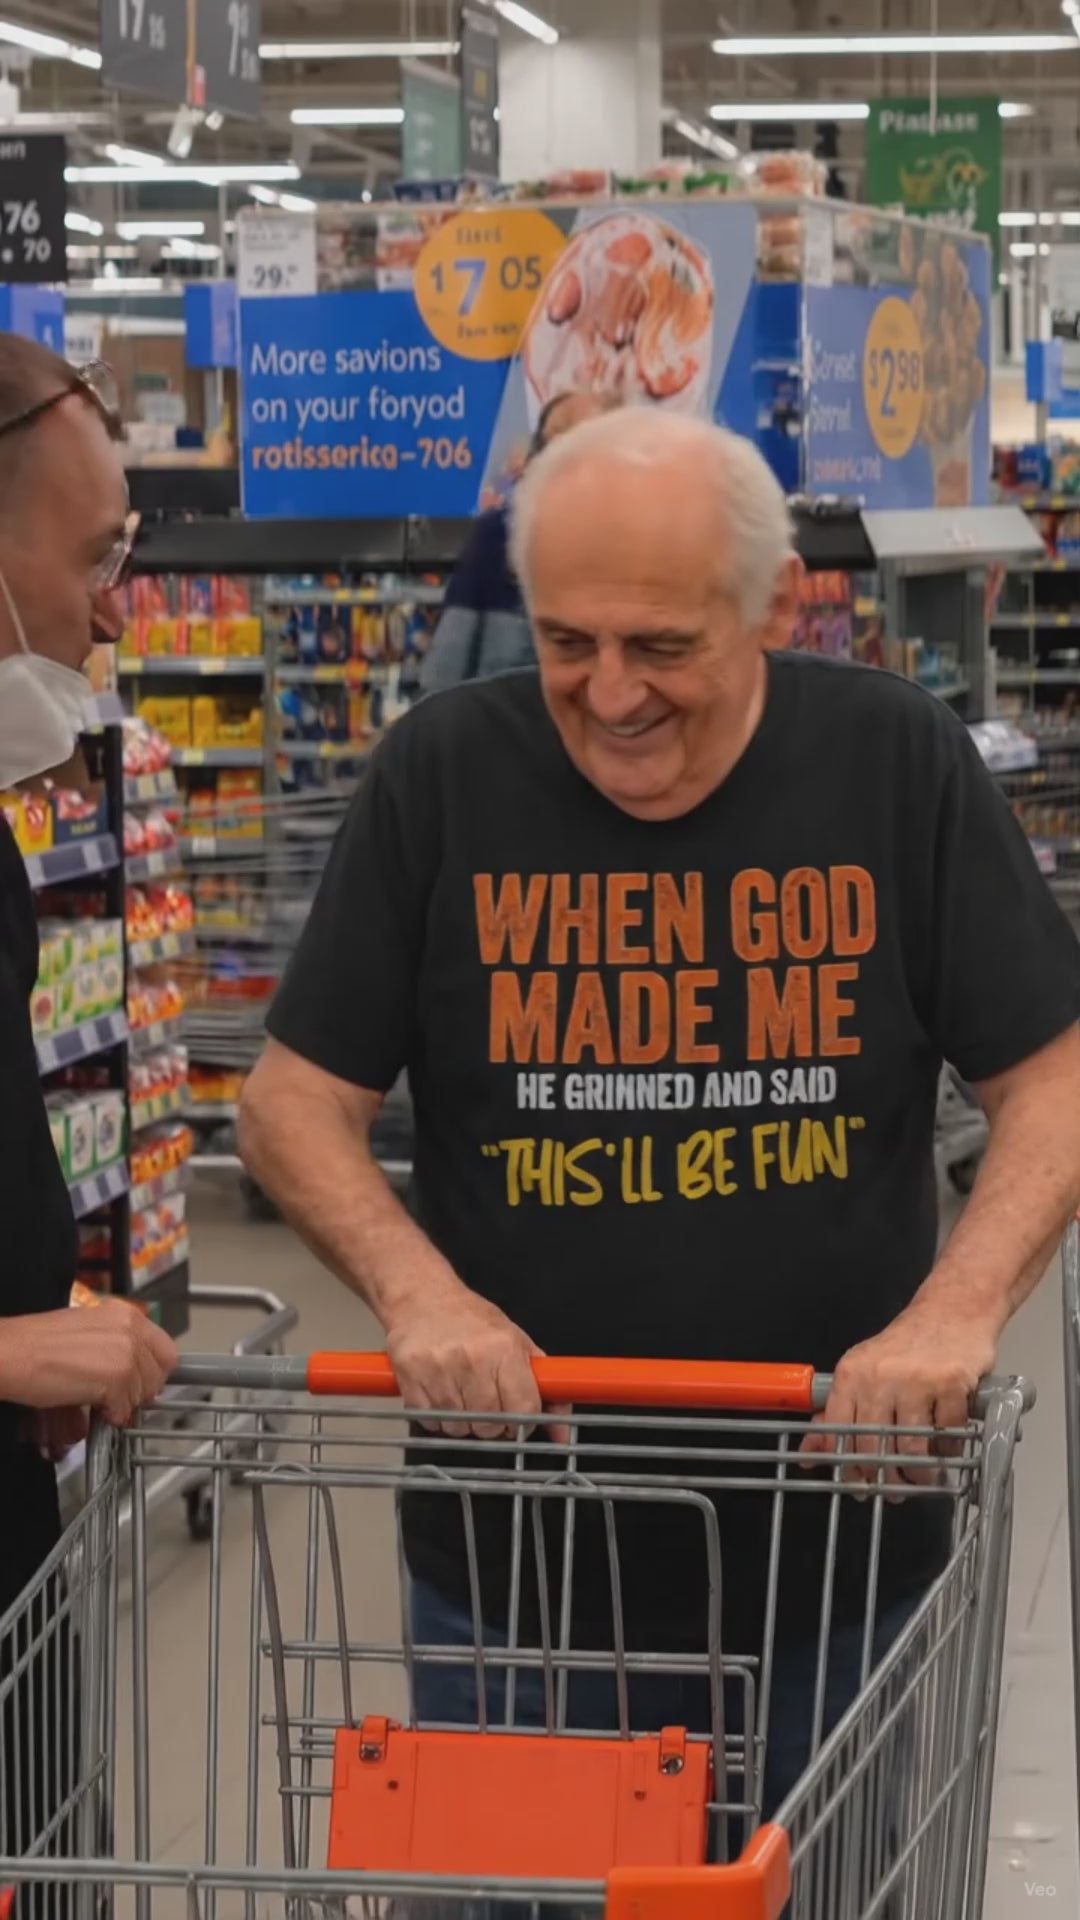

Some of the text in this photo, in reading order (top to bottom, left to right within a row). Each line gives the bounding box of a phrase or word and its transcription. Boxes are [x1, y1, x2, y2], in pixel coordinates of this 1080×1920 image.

[0, 200, 41, 235] 76
[250, 337, 442, 377] More savions
[251, 396, 289, 424] on
[295, 395, 360, 432] your
[473, 865, 876, 965] WHEN GOD
[489, 962, 861, 1065] MADE ME
[516, 1072, 556, 1110] HE
[701, 1070, 763, 1109] AND
[769, 1066, 837, 1105] SAID
[676, 1127, 738, 1200] BE
[752, 1115, 866, 1191] FUN"
